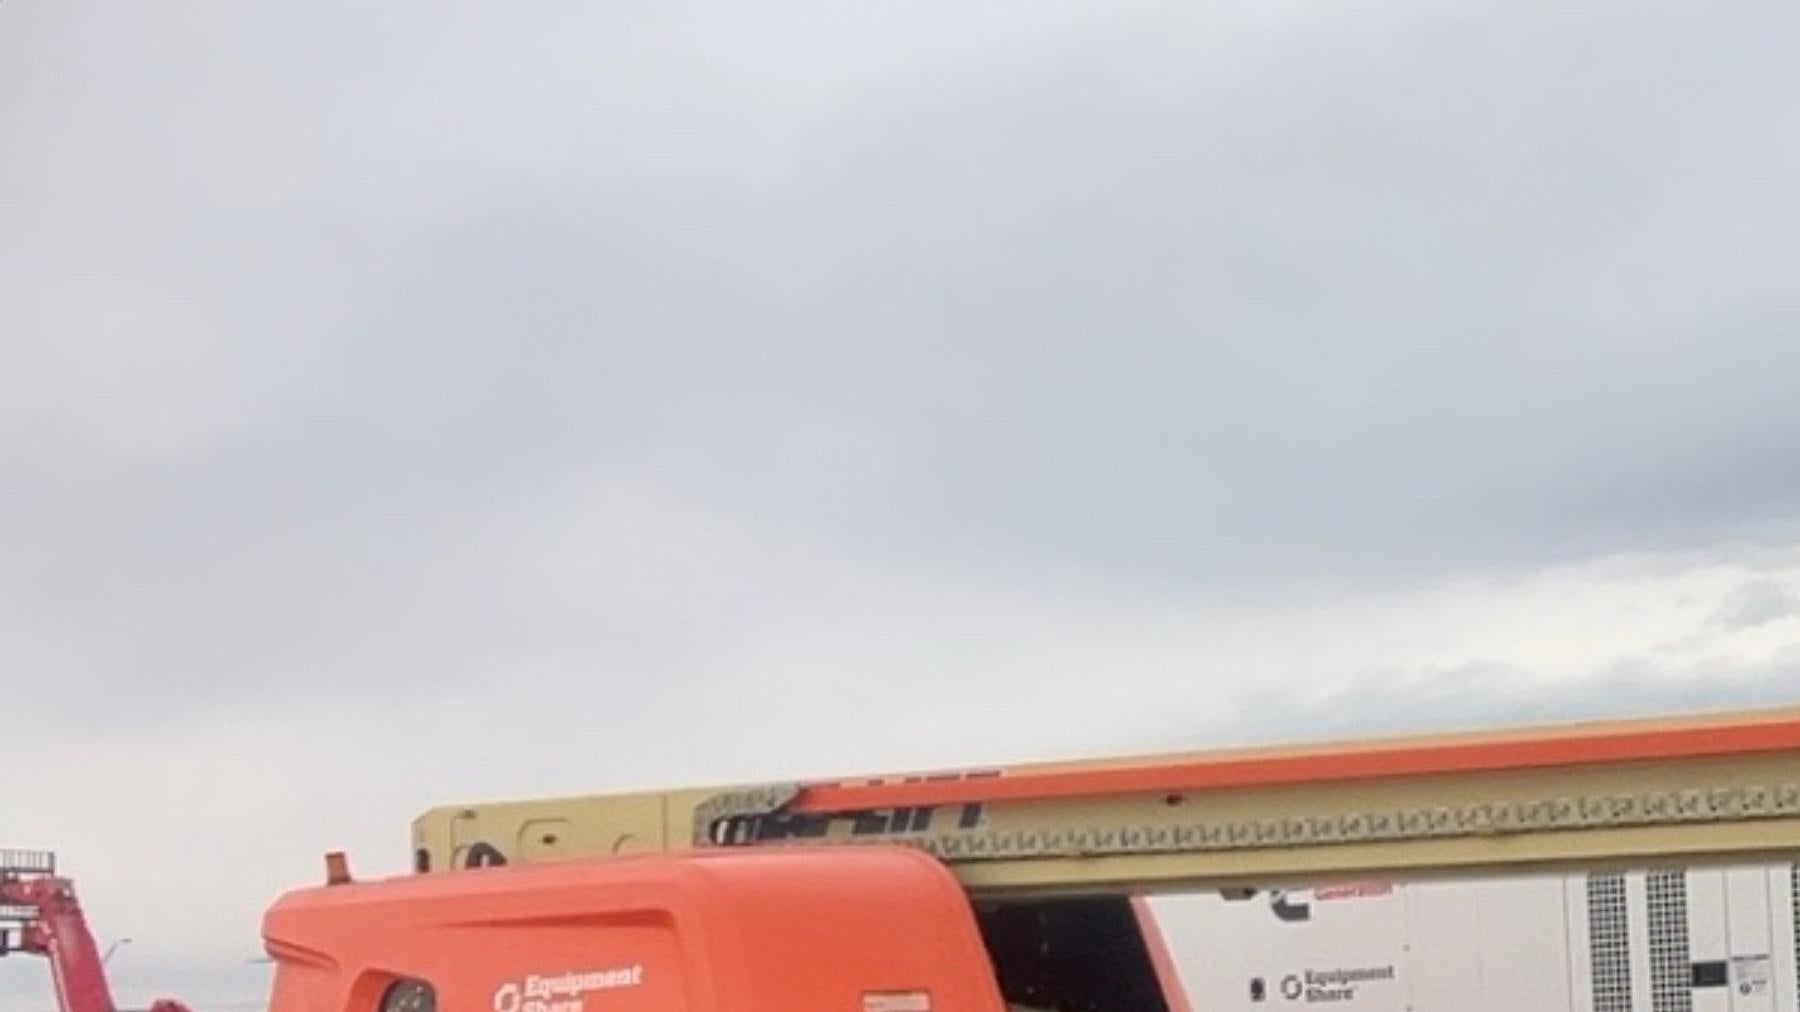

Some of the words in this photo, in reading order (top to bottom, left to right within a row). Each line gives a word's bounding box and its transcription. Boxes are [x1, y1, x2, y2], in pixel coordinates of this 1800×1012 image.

[525, 965, 643, 999] Equipment
[1305, 965, 1395, 986] Equipment
[1305, 987, 1355, 1002] Share
